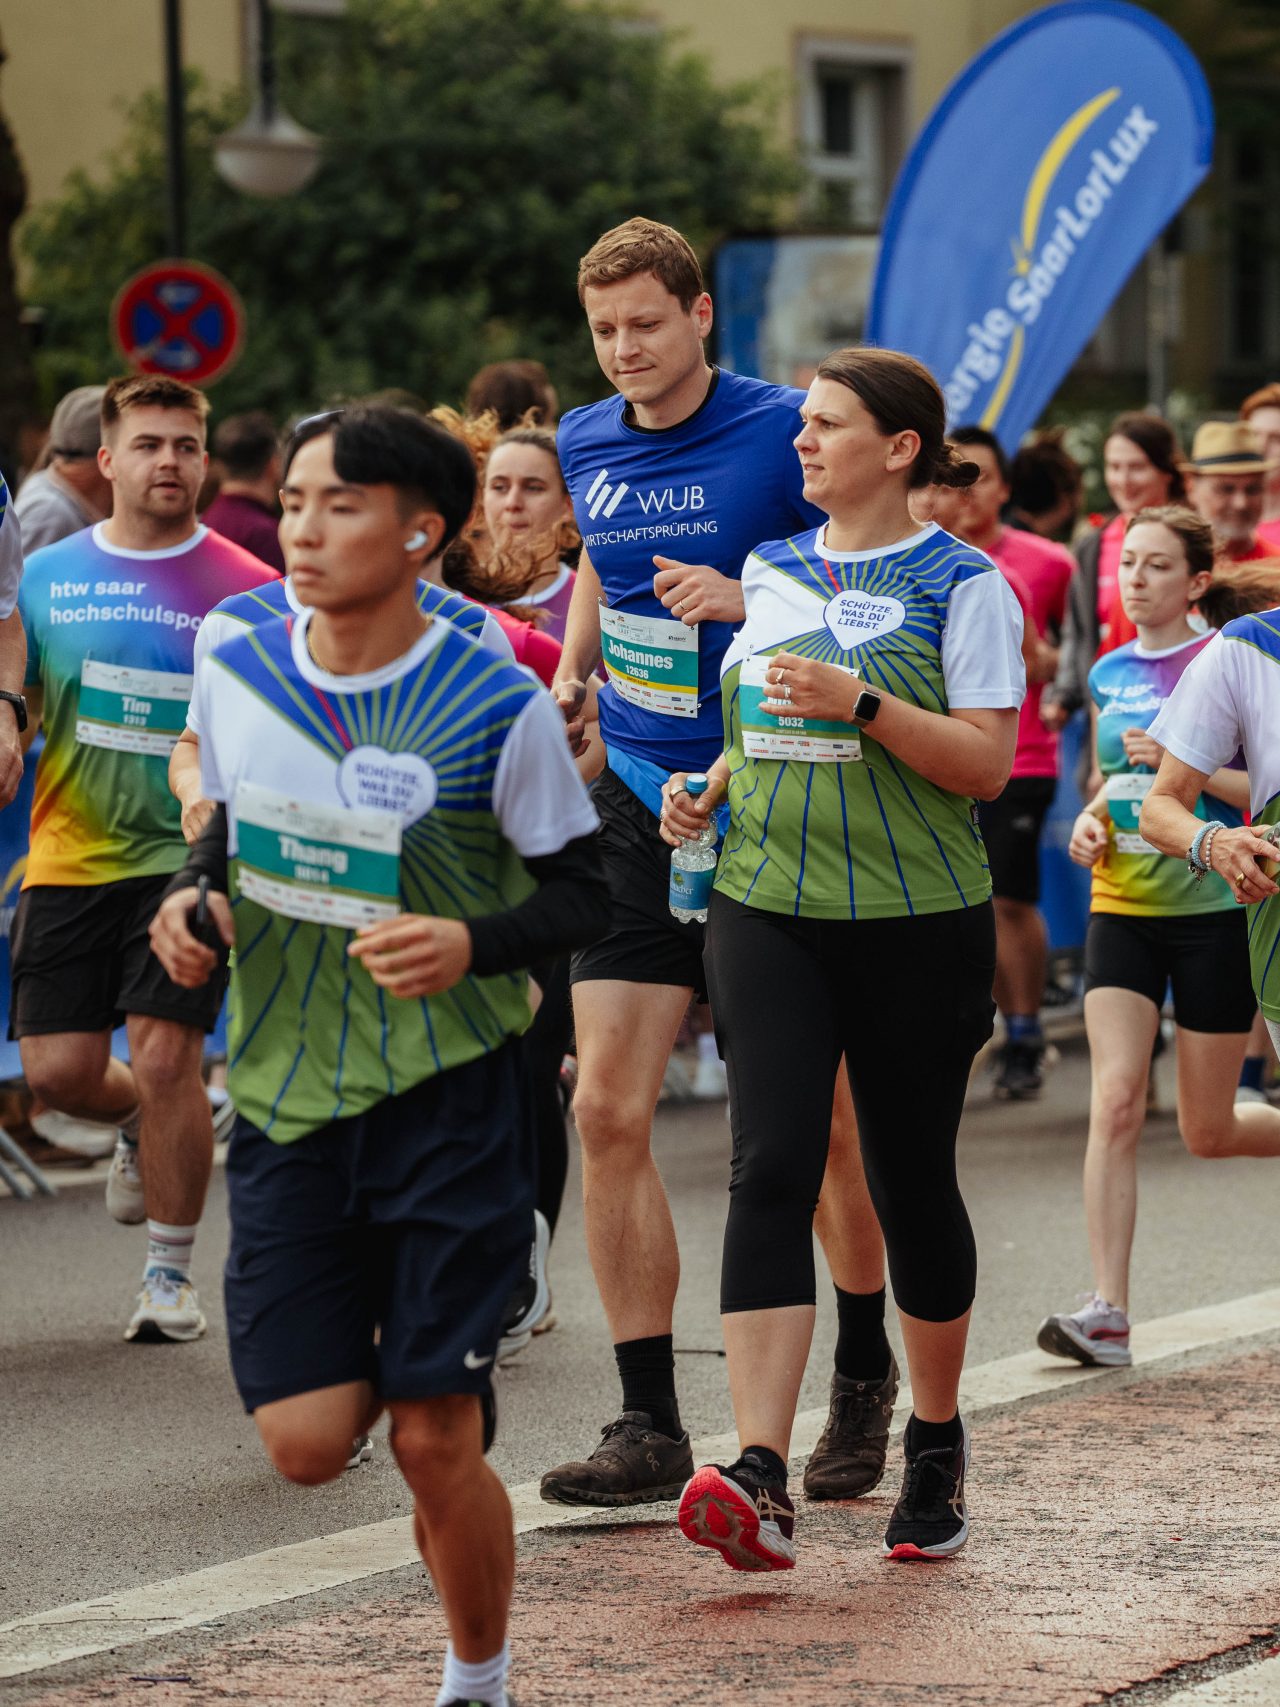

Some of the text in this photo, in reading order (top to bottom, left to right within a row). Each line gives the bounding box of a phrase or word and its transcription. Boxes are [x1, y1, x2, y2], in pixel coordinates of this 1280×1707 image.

[944, 104, 1160, 427] ergie SaarLorLux
[636, 485, 705, 514] WUB
[50, 581, 147, 599] htw saar
[50, 602, 204, 631] hochschulspo
[839, 599, 893, 615] SCHÜTZE,
[841, 608, 885, 622] WAS DU
[837, 618, 879, 630] LIEBST.
[608, 640, 674, 669] Johannes
[625, 665, 649, 679] 12636
[122, 695, 151, 715] Tim
[778, 716, 804, 727] 5032
[278, 834, 348, 874] Thang
